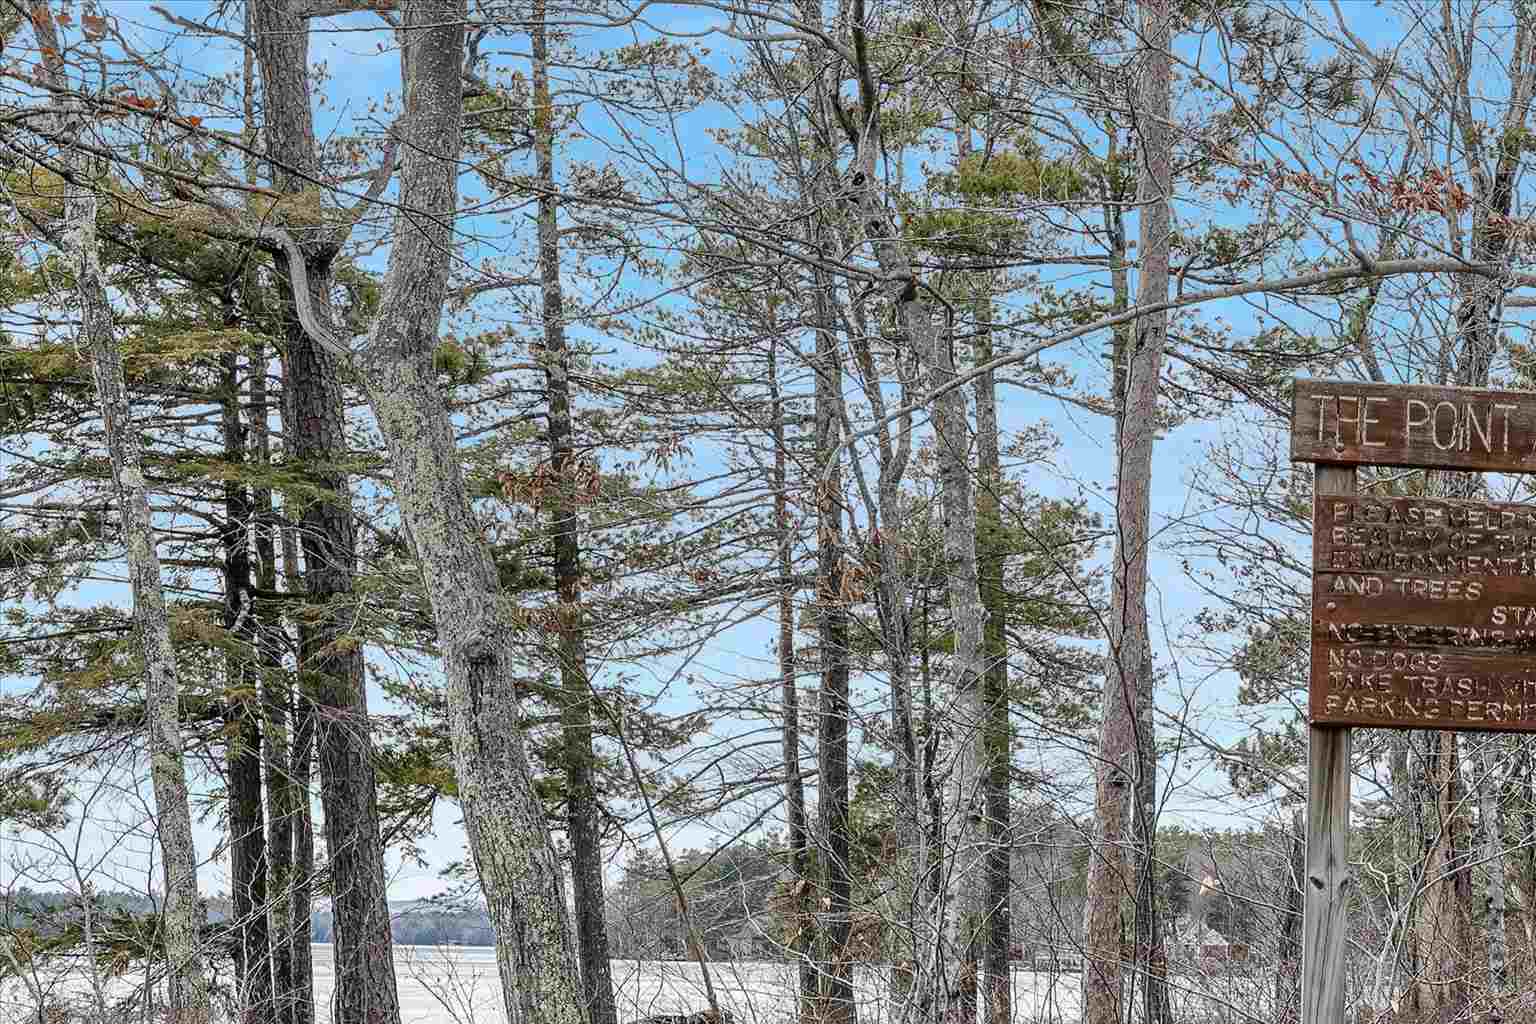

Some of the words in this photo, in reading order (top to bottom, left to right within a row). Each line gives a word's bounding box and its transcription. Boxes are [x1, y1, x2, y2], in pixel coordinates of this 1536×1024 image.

[1311, 395, 1387, 447] THE
[1407, 399, 1518, 452] POINT
[1331, 575, 1383, 598] AND
[1394, 578, 1484, 601] TREES
[1329, 671, 1393, 693] TAKE
[1403, 675, 1494, 697] TRASH
